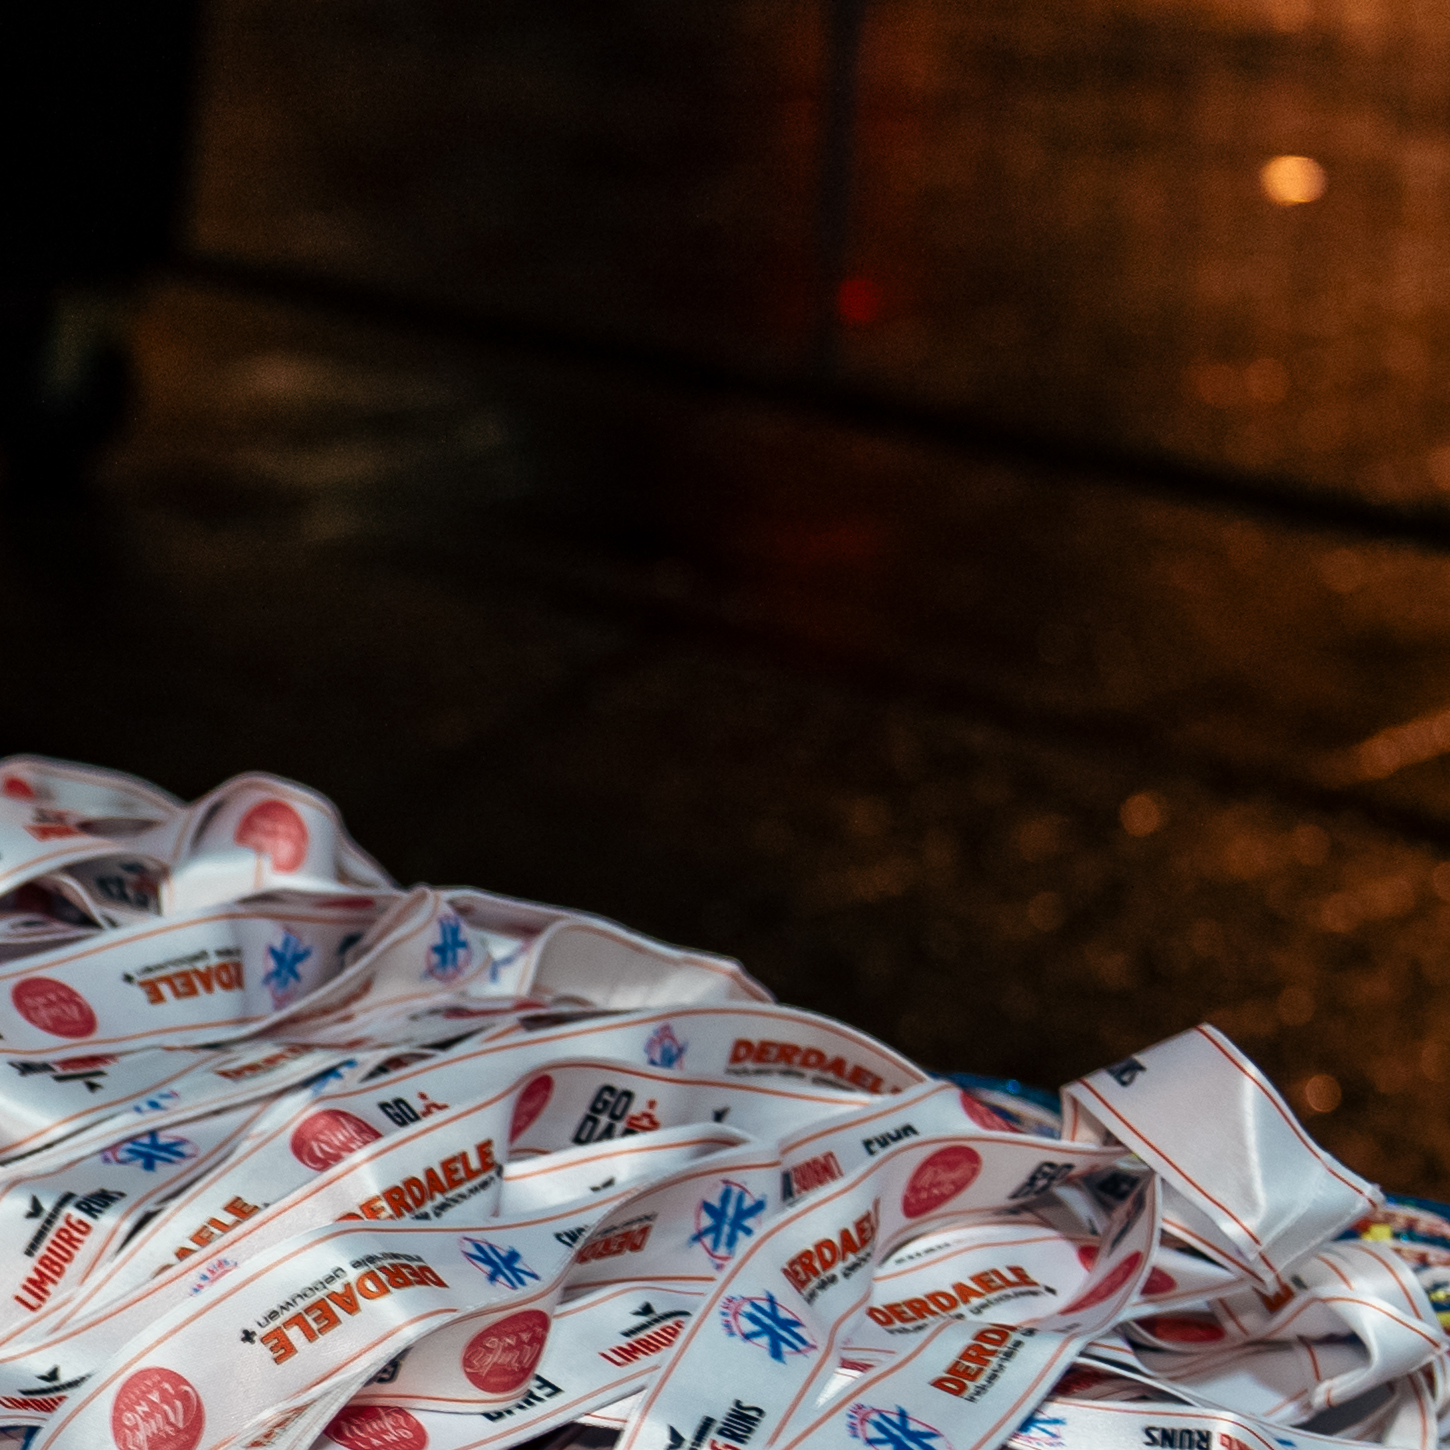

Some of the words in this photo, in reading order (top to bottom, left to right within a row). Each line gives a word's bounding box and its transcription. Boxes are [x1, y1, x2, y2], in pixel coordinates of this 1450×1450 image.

[377, 1096, 421, 1128] GO
[589, 1084, 636, 1122] GO
[13, 1212, 94, 1314] LIMBURG
[260, 1263, 450, 1366] DERDAELE
[866, 1264, 1041, 1329] DERDAELE
[716, 1398, 766, 1445] RUNS
